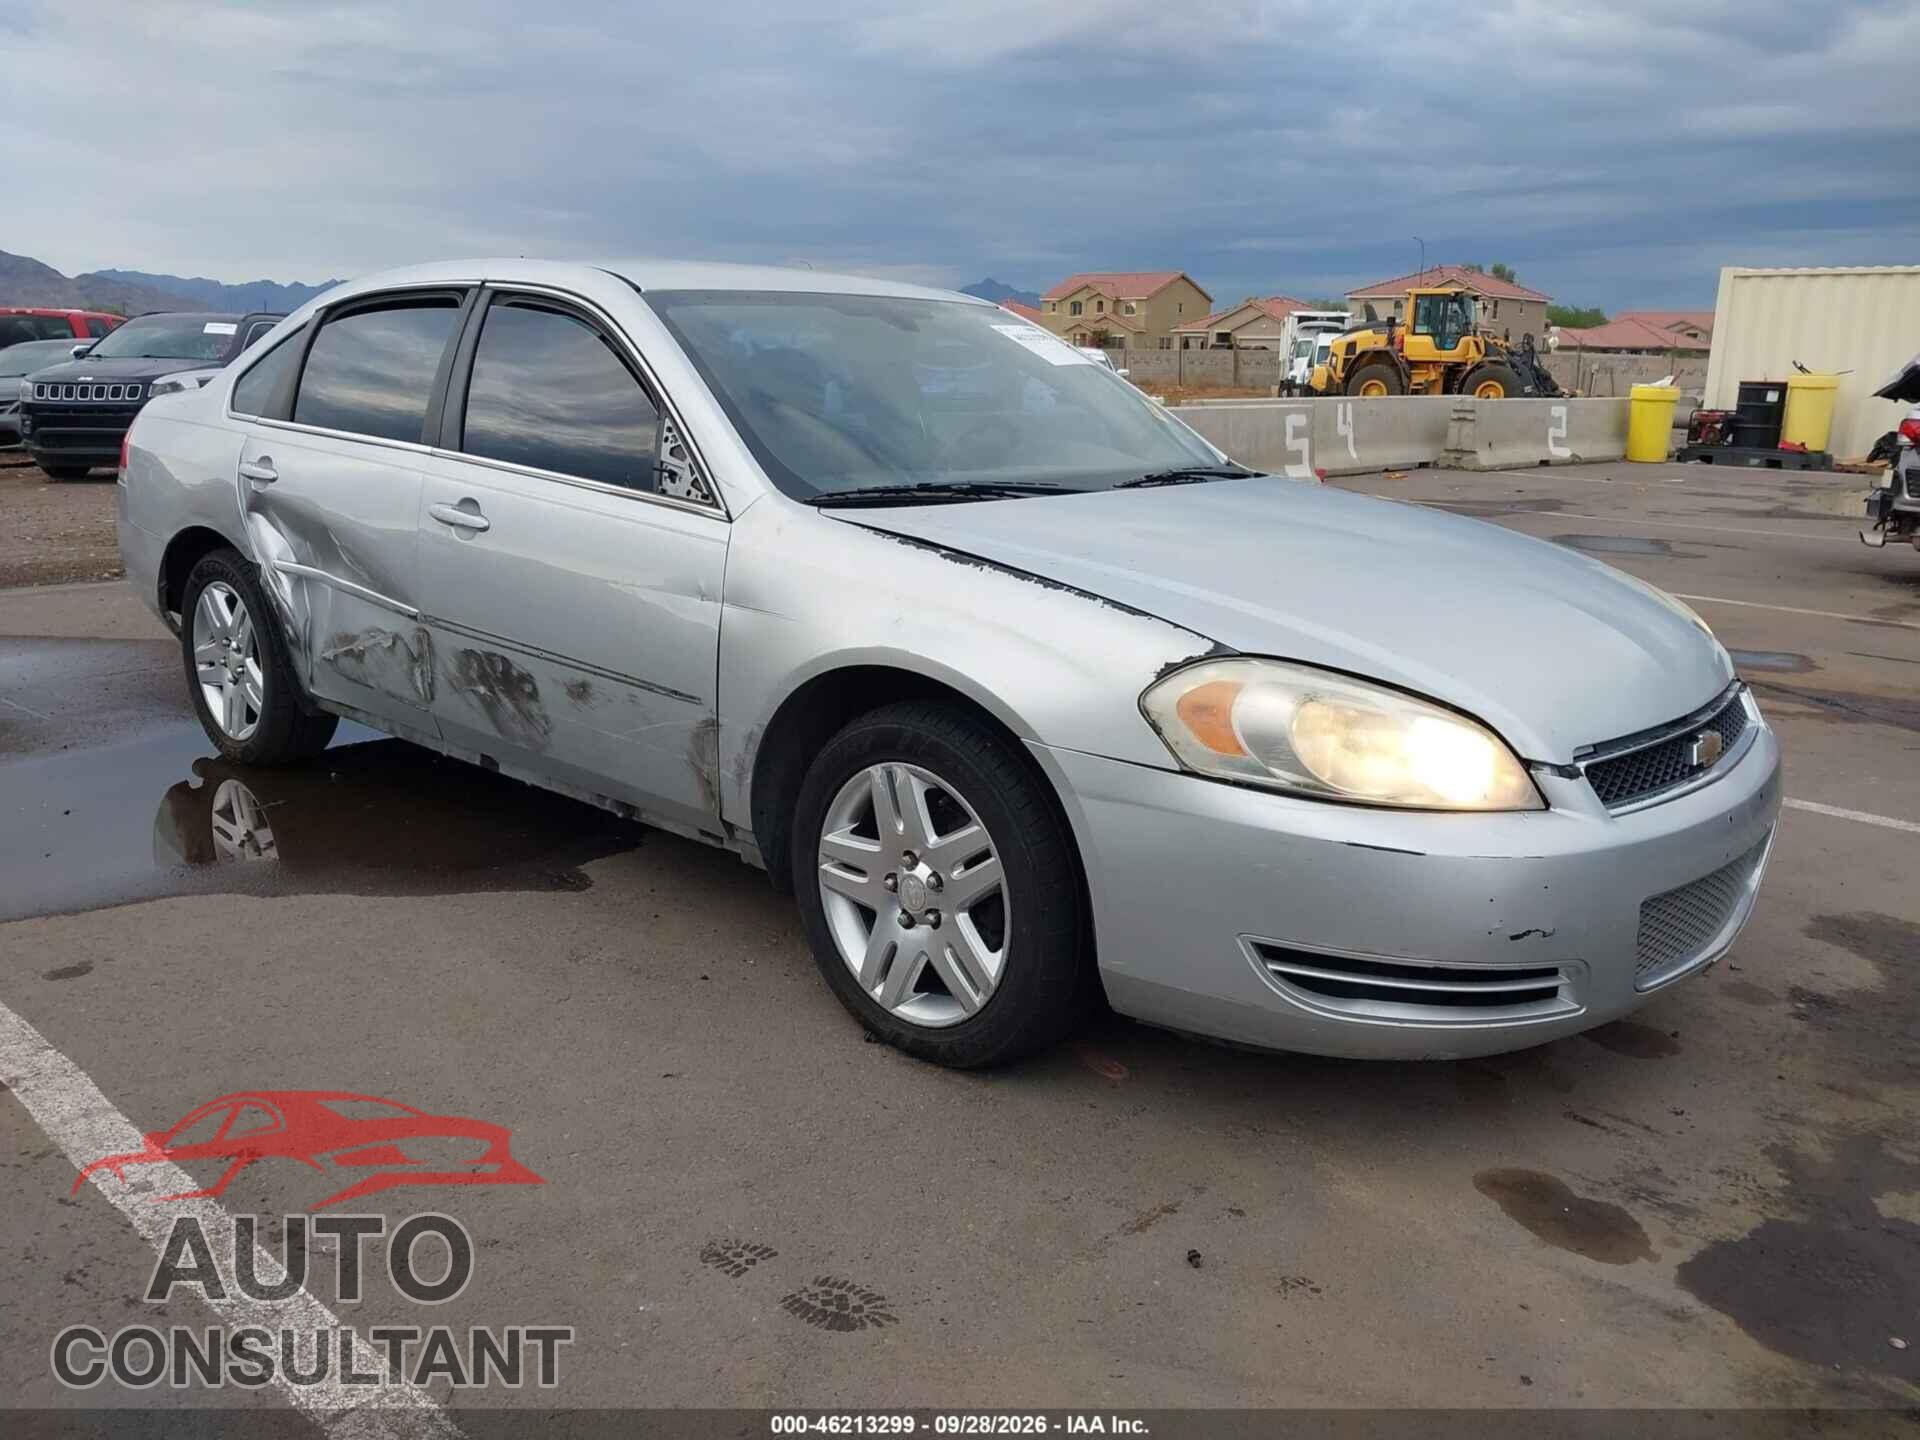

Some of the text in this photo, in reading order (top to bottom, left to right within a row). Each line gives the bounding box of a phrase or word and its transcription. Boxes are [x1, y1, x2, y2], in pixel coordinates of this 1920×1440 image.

[1284, 414, 1312, 477] 5
[1337, 402, 1358, 461] 4
[1548, 406, 1571, 457] 2
